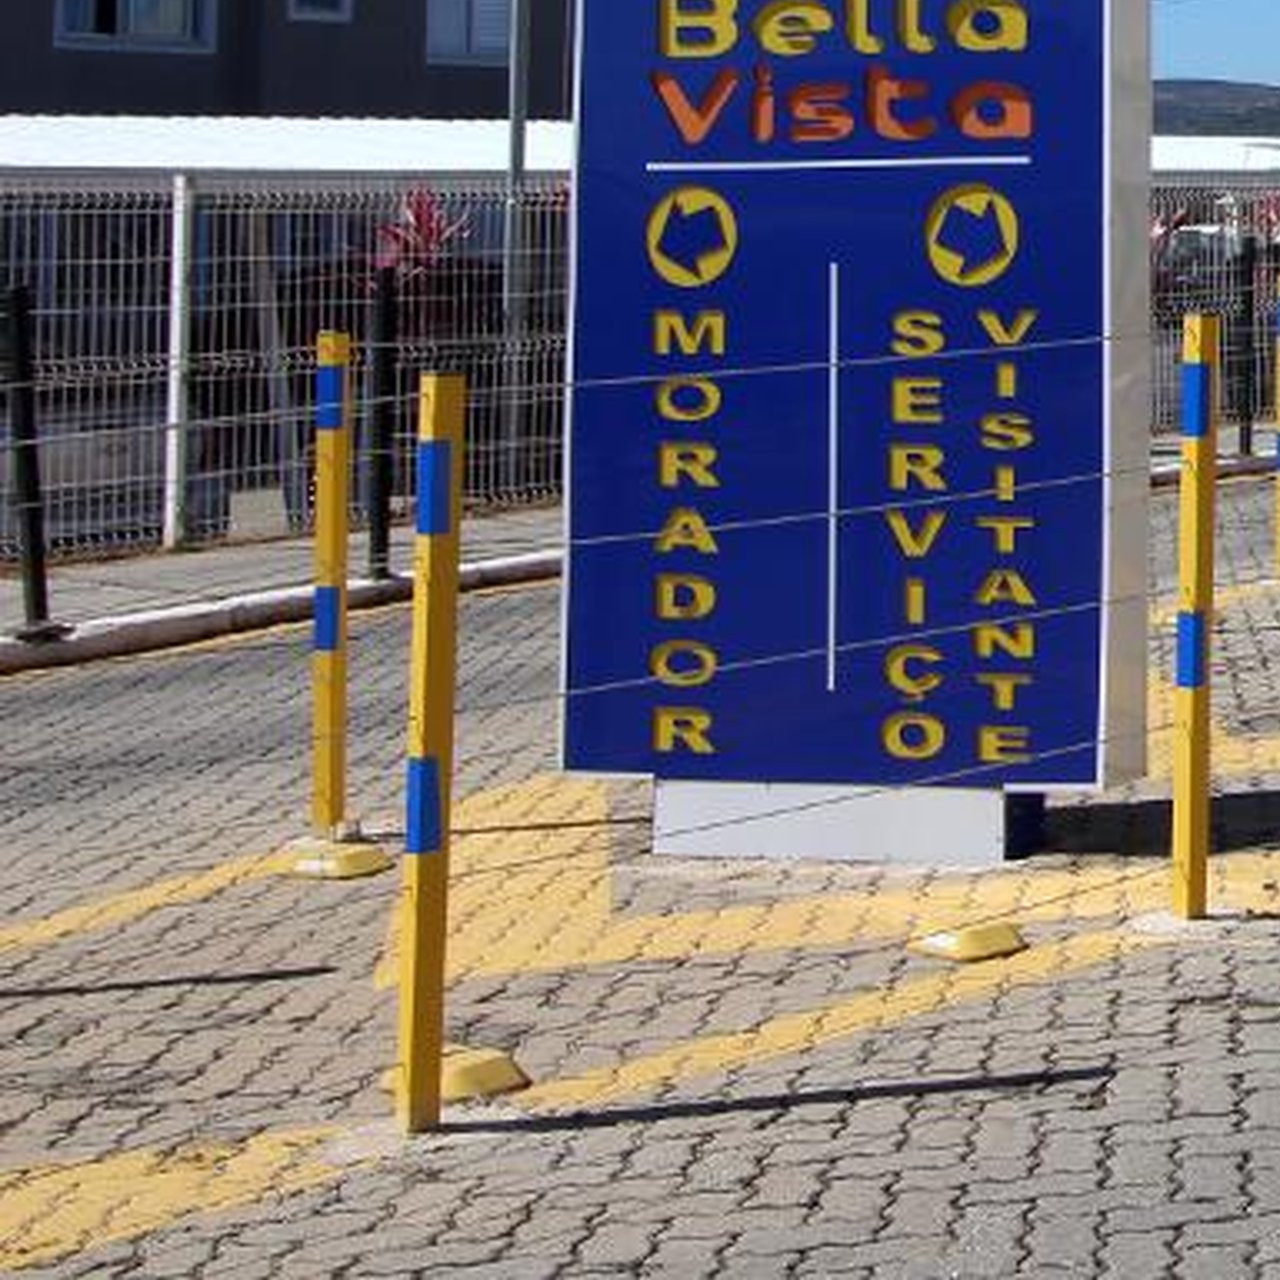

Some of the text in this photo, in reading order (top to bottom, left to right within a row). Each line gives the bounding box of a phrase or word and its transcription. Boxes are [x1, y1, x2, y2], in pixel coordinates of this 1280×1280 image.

[652, 61, 1034, 145] Vista
[650, 310, 725, 754] MORADOR
[881, 311, 946, 760] SERVIÇO
[972, 310, 1038, 764] VISITANTE
